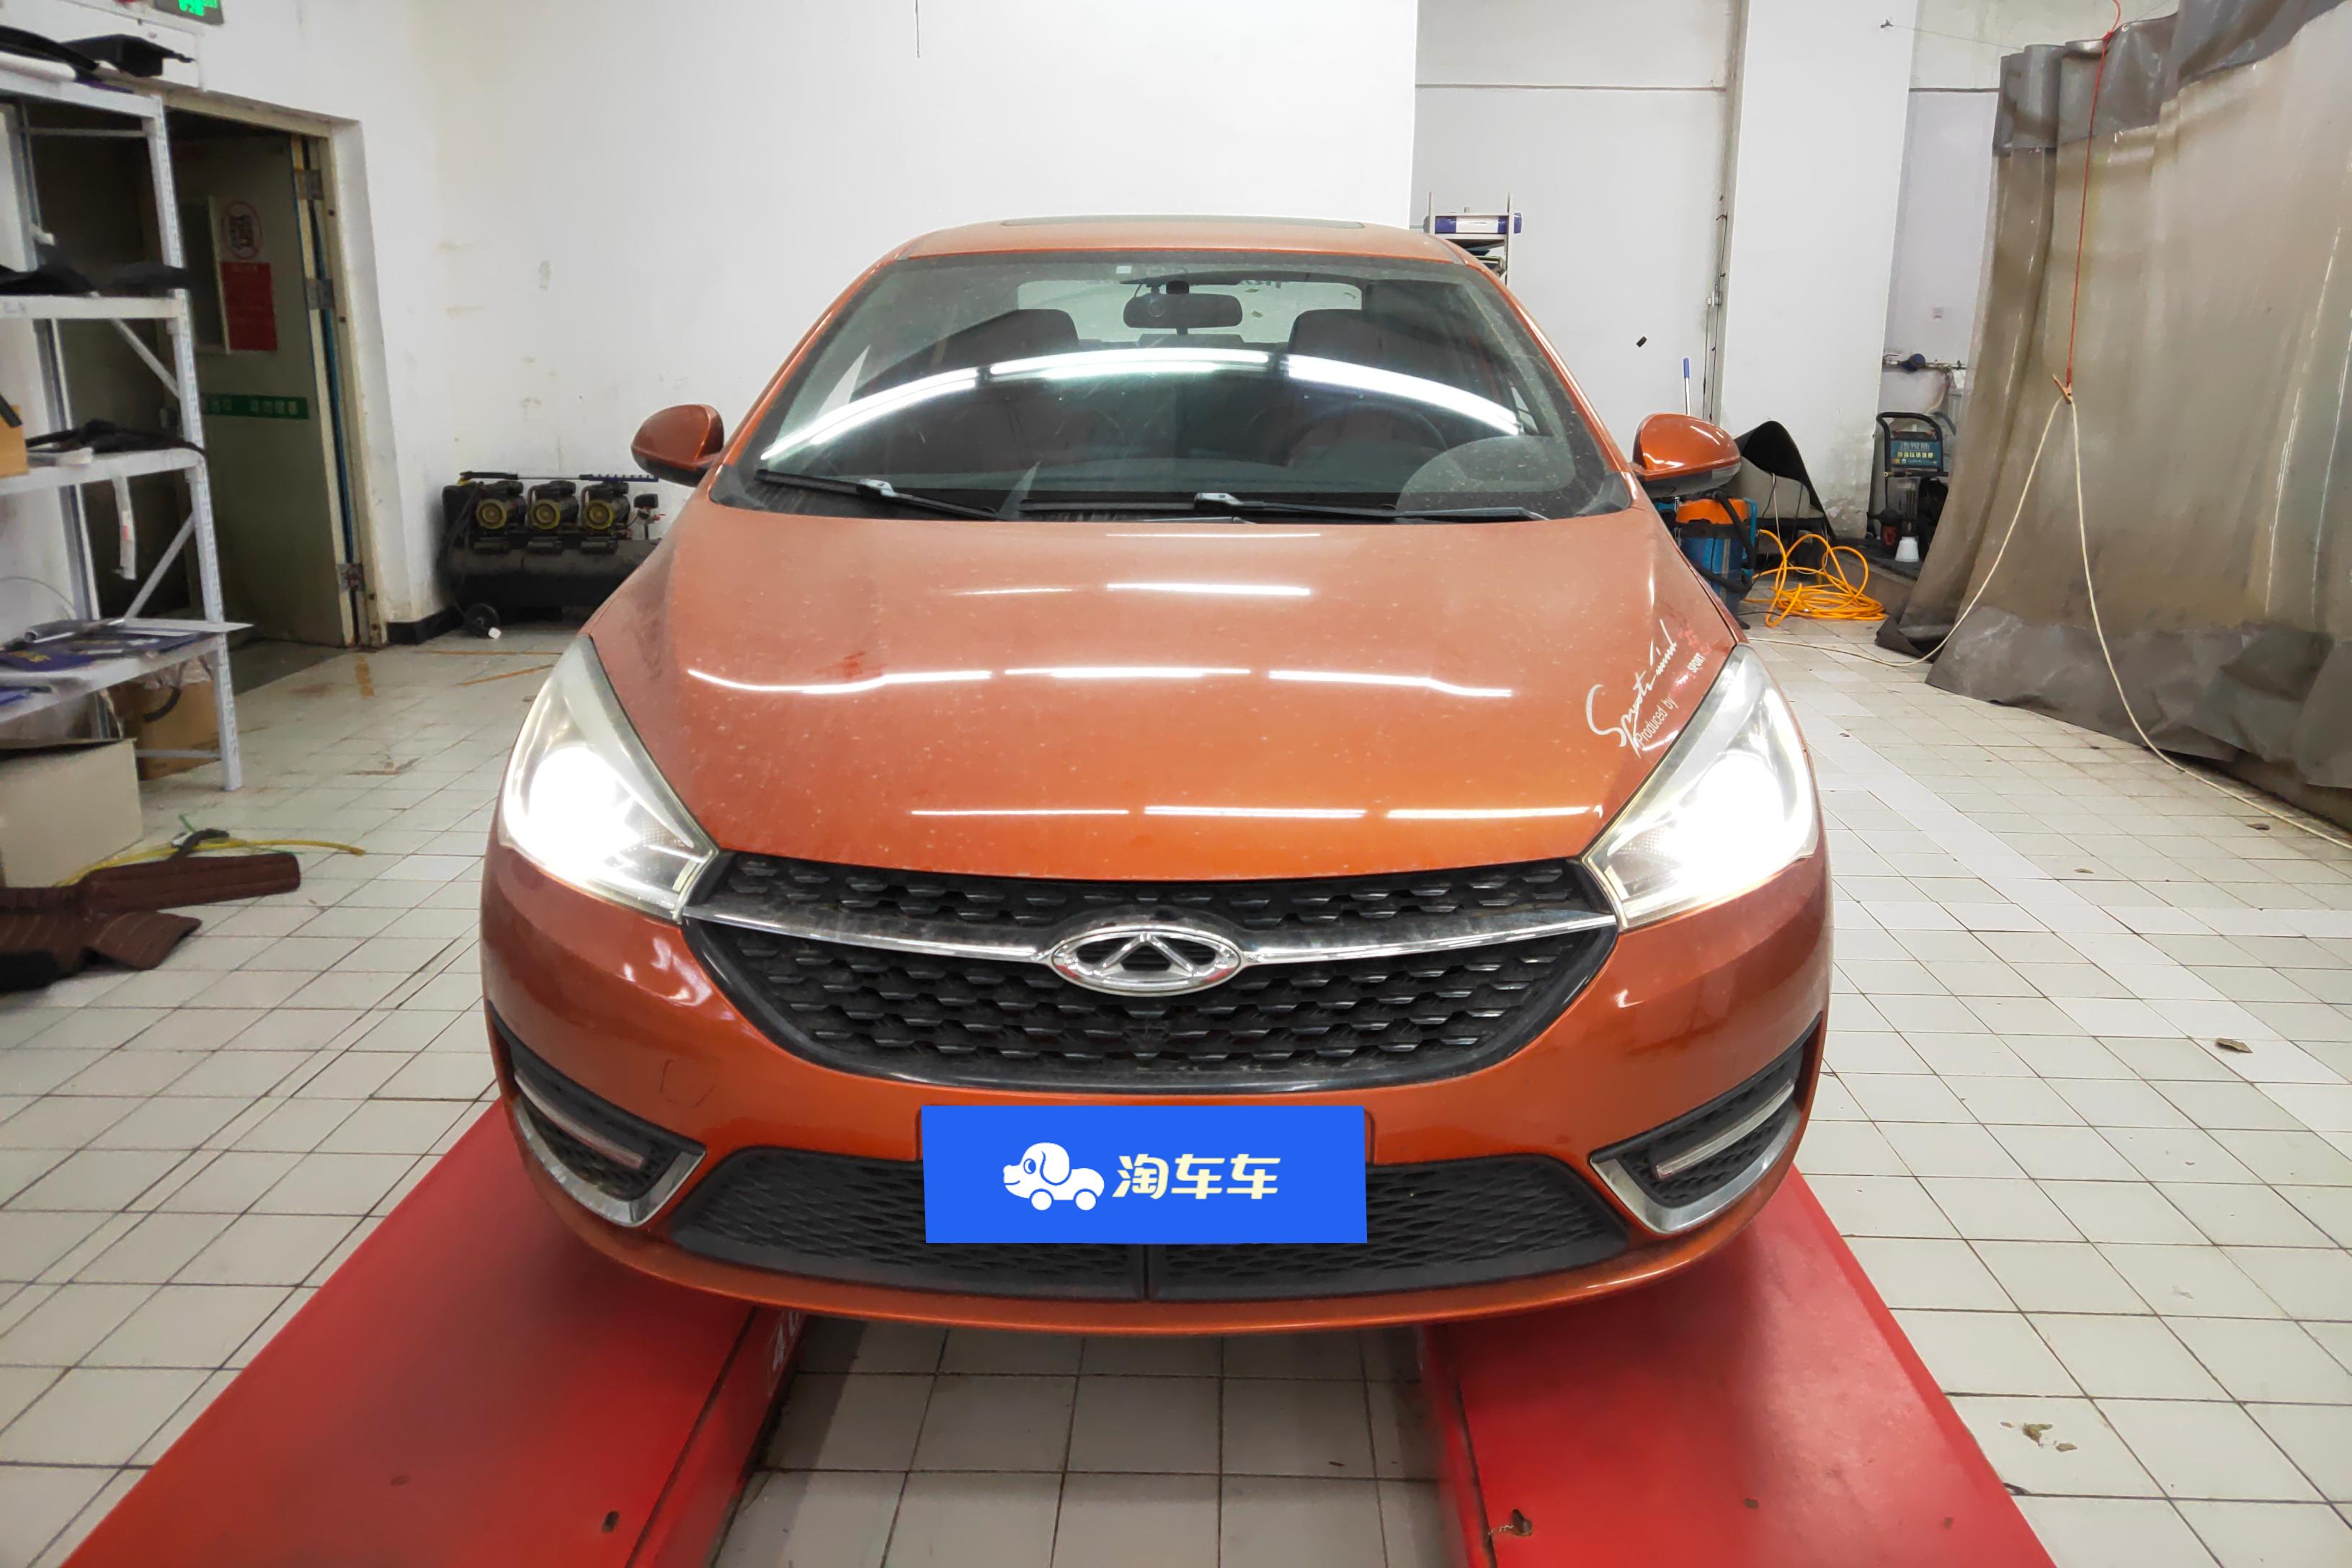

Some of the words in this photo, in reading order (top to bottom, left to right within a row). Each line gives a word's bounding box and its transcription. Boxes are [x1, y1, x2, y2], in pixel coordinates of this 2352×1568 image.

[1634, 704, 1668, 747] Produced
[1662, 696, 1679, 709] by
[1687, 652, 1706, 673] SPORT
